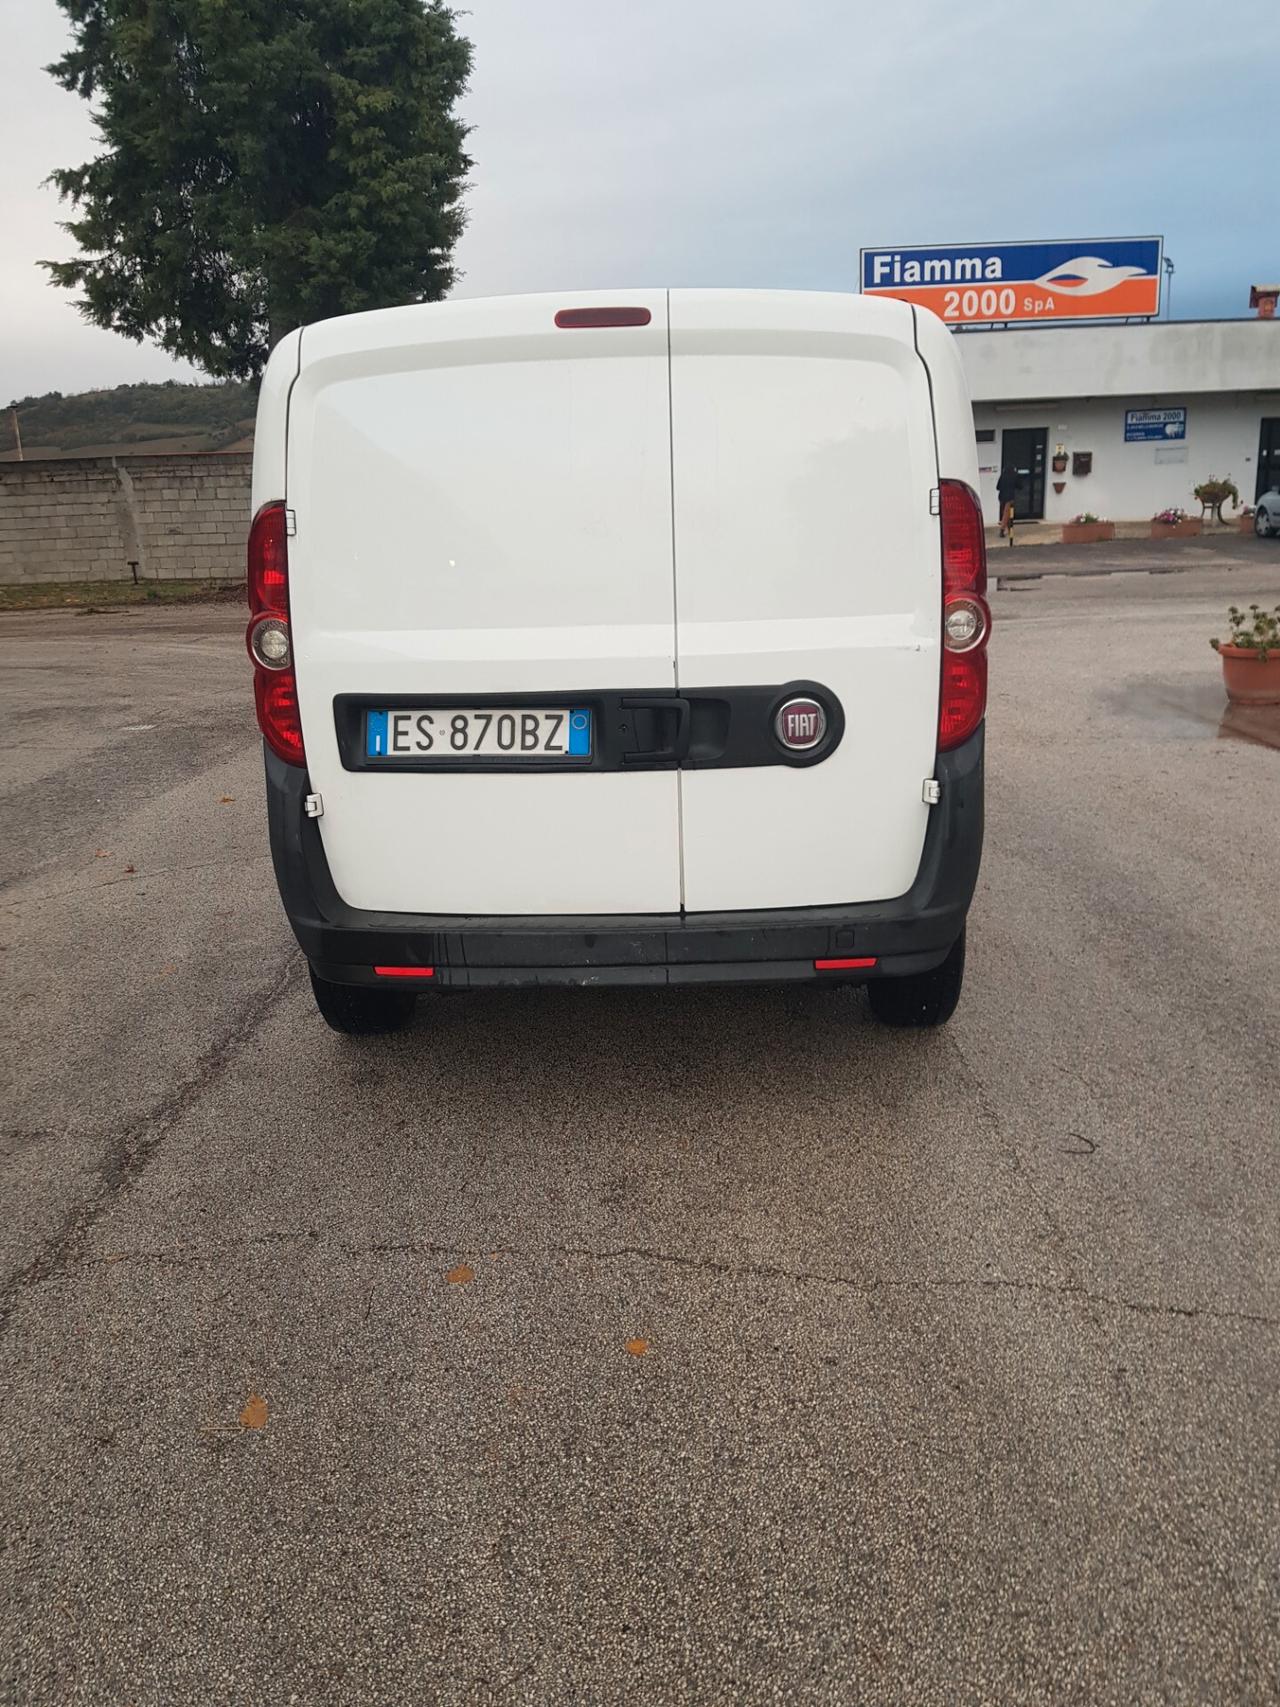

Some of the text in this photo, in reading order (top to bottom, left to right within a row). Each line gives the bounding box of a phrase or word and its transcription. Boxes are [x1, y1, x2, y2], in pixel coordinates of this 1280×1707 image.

[873, 255, 1003, 283] Fiamma
[944, 288, 1055, 317] 2000 SpA
[1130, 411, 1181, 422] Fiamma 2000
[392, 714, 434, 752] ES
[450, 713, 564, 752] 870BZ
[788, 714, 816, 736] FIAT
